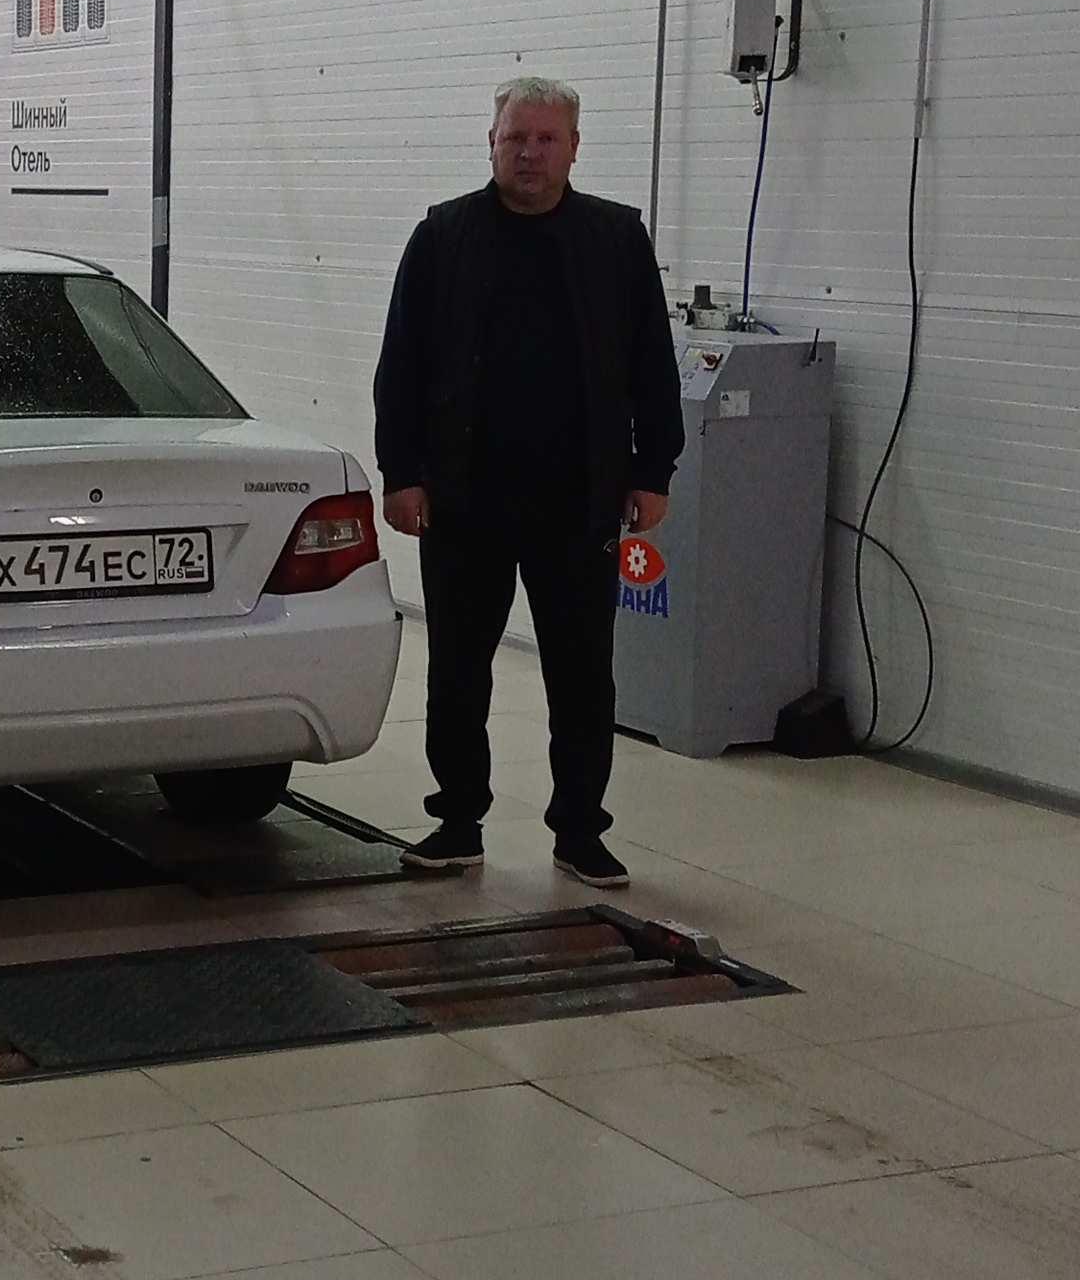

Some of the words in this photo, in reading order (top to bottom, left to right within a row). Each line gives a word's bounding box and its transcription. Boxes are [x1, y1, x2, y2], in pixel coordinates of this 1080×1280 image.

[12, 97, 67, 129] Шинный
[11, 144, 50, 172] Отель
[158, 537, 195, 569] 72
[158, 567, 184, 580] RUS
[617, 576, 668, 618] AHA
